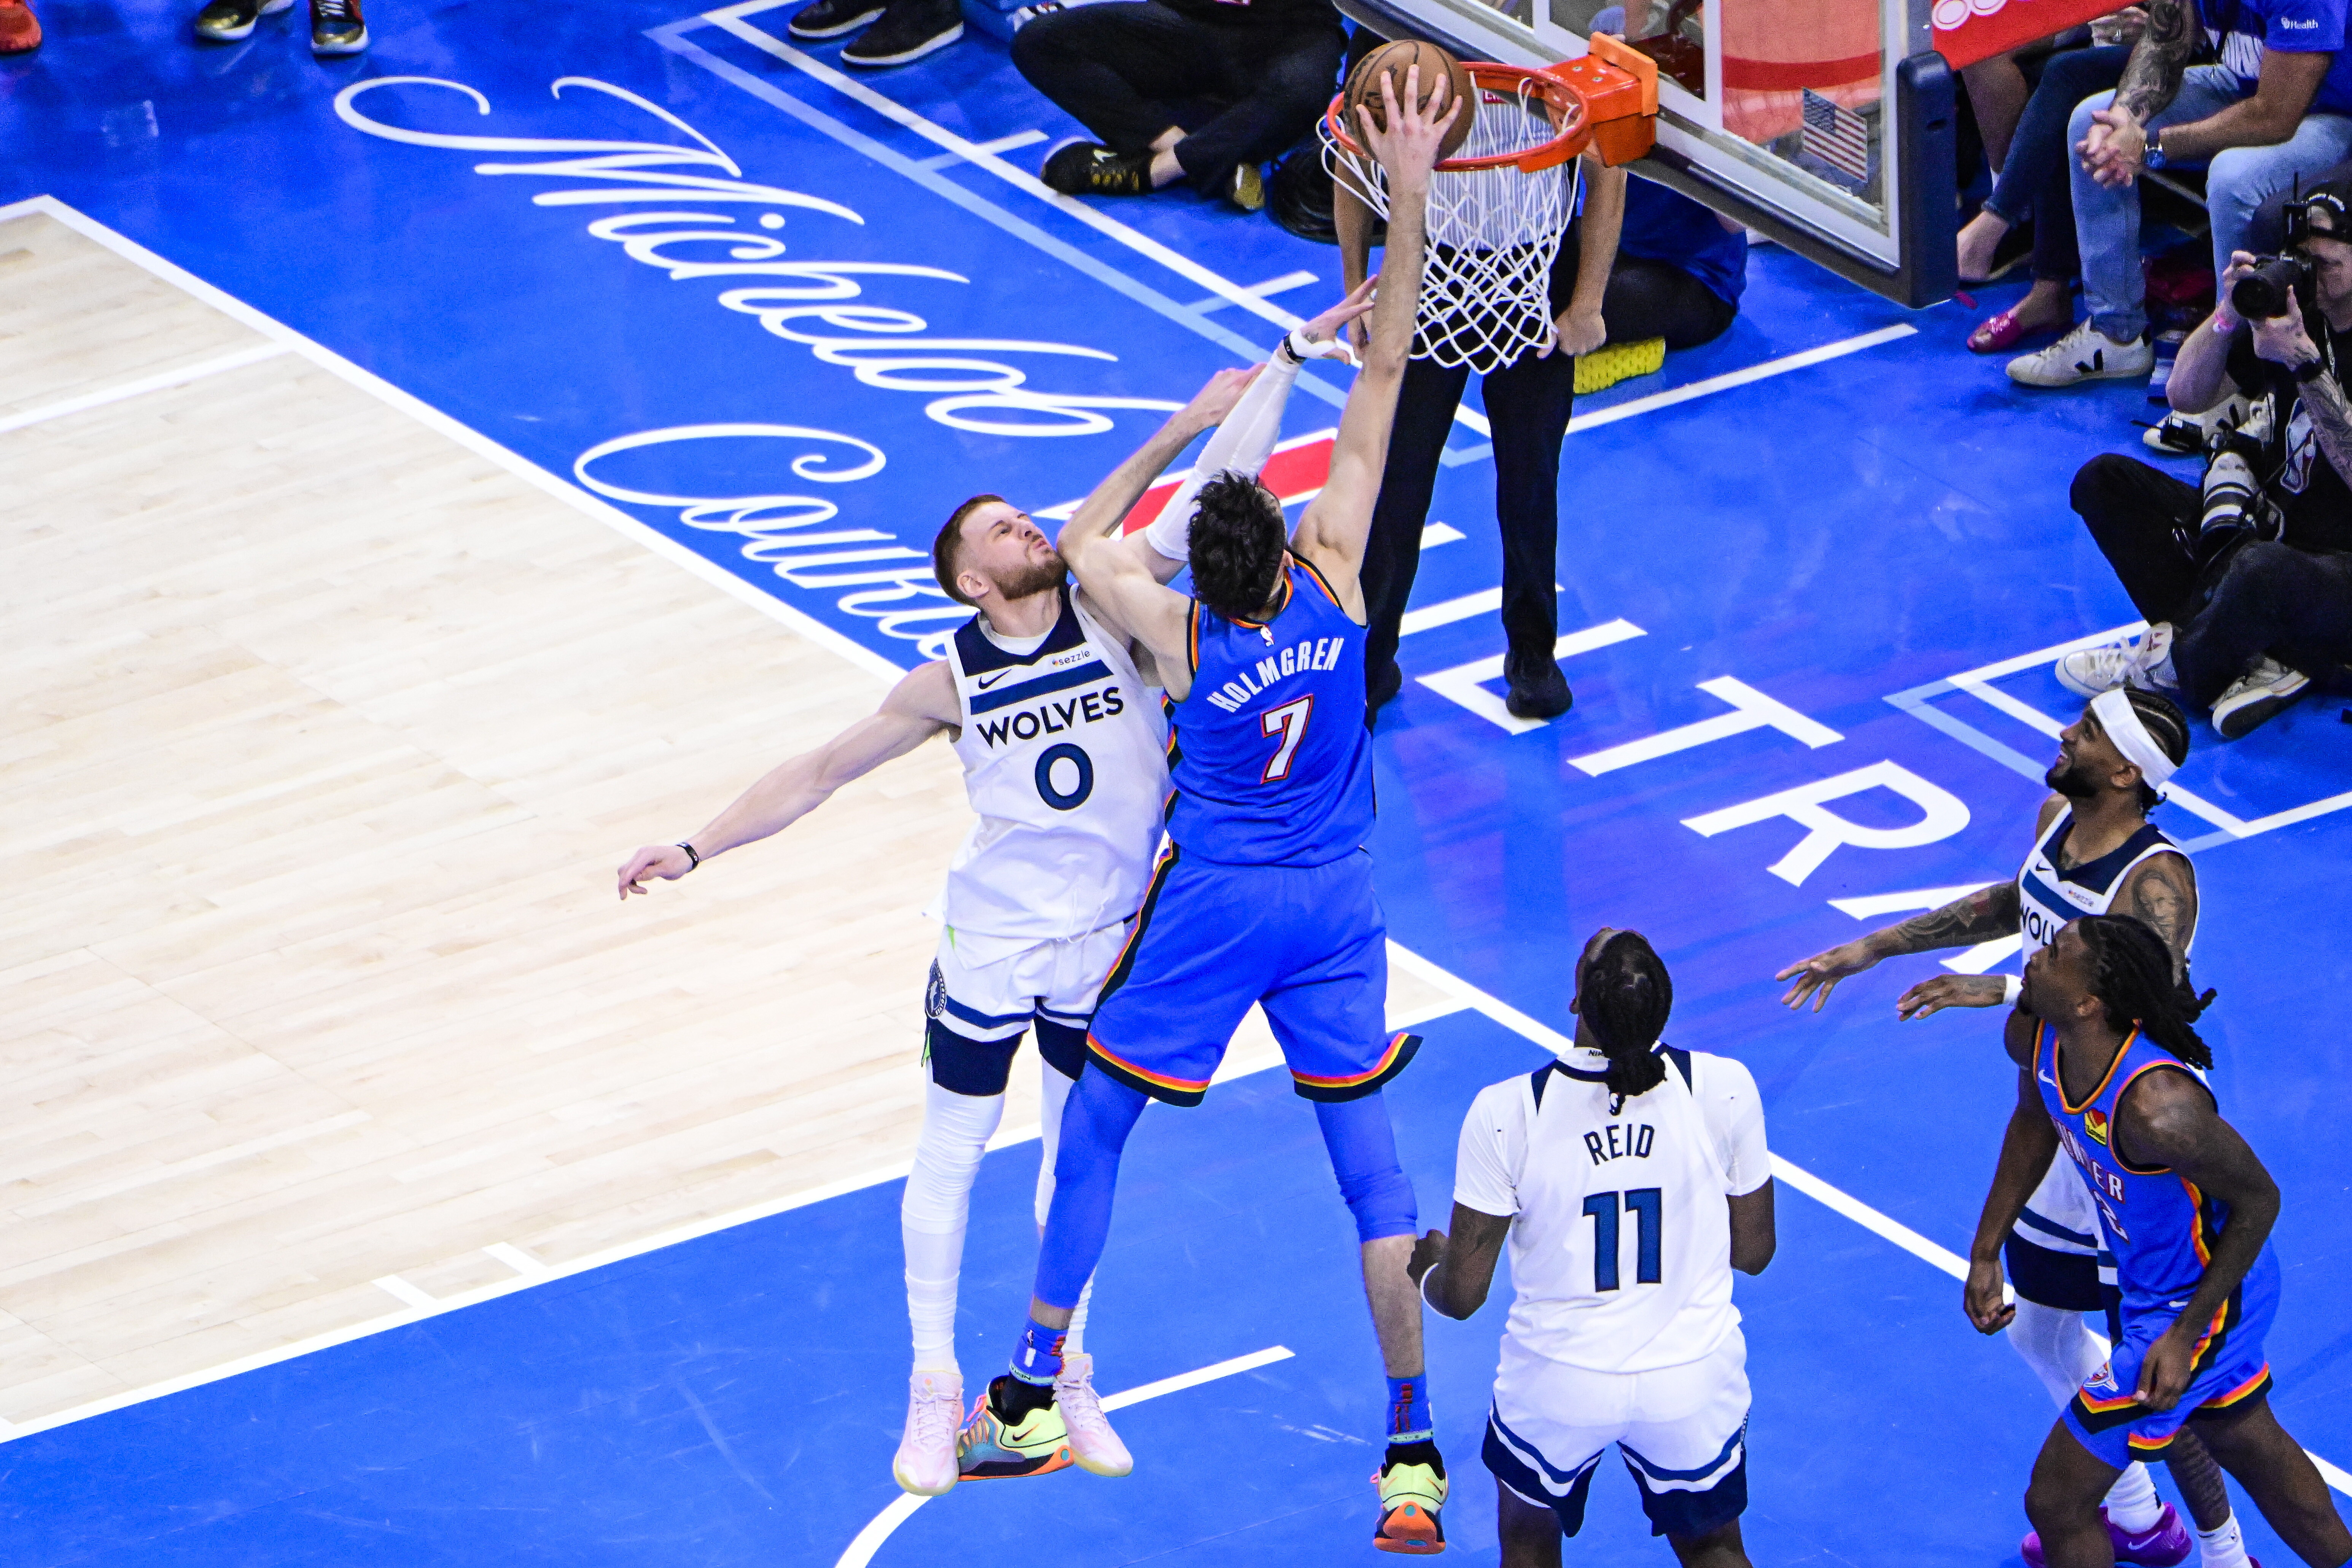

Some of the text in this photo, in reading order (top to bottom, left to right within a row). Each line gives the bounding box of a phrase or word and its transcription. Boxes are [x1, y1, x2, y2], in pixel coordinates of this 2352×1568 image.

[334, 75, 1188, 437] Michelob
[1058, 649, 1091, 666] sezzle
[1206, 638, 1345, 713] HOLMGREN
[976, 686, 1124, 749] WOLVES
[1260, 694, 1314, 784] 7
[1034, 743, 1094, 811] 0
[1584, 1123, 1655, 1165] REID
[1582, 1187, 1662, 1293] 11
